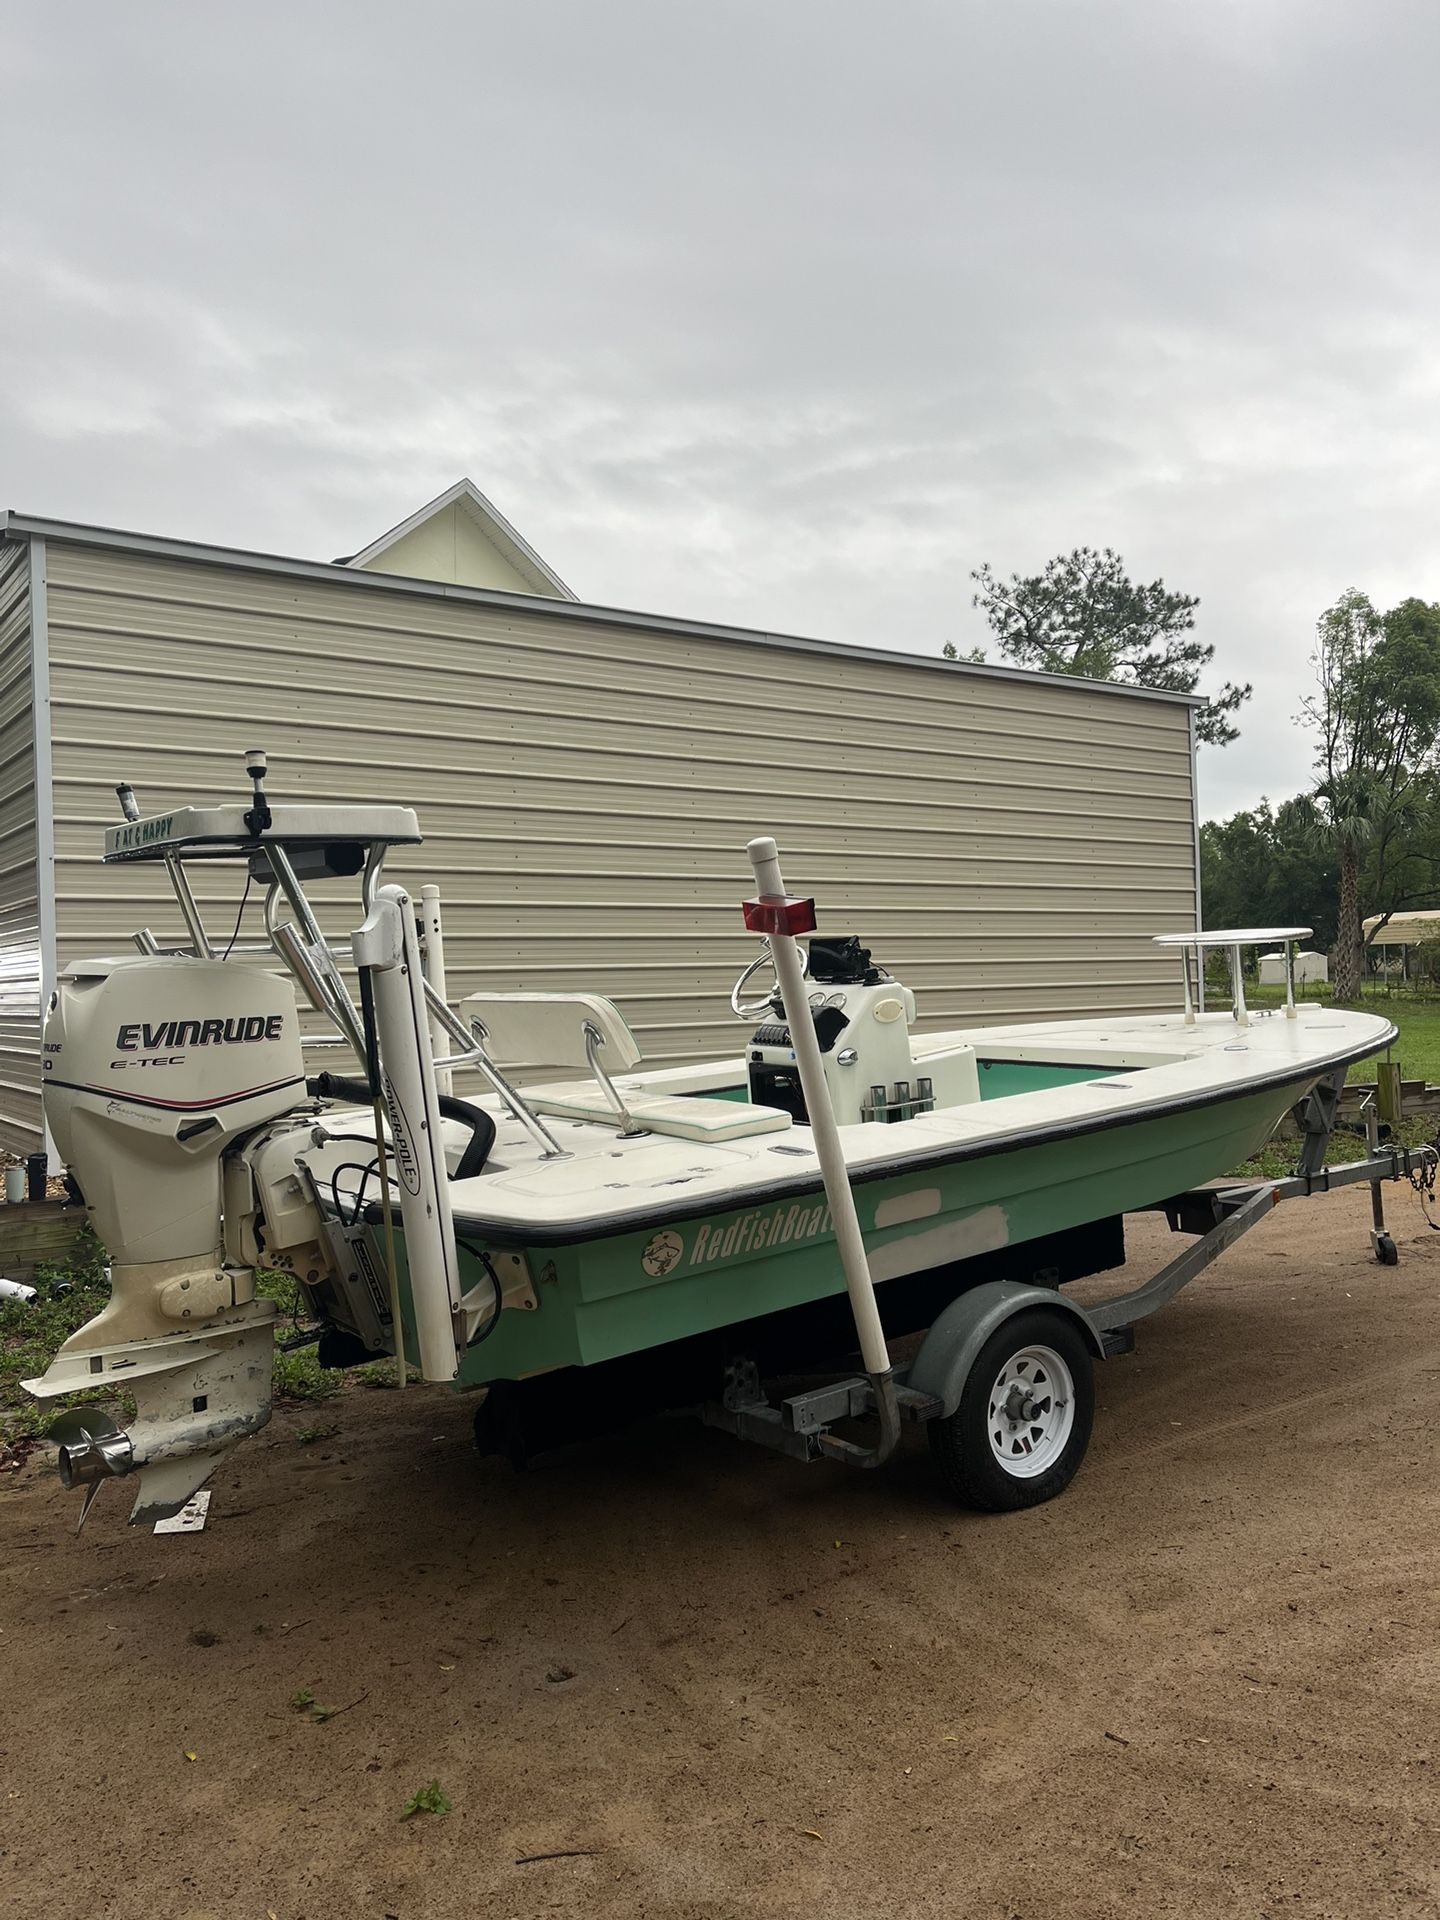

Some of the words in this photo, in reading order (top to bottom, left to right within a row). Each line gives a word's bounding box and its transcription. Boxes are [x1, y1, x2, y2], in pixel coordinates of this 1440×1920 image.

[142, 817, 173, 841] HAPPY
[116, 1015, 283, 1051] EVINRUDE
[110, 1056, 186, 1069] E-TEC
[689, 1203, 835, 1265] RedFishBoat
